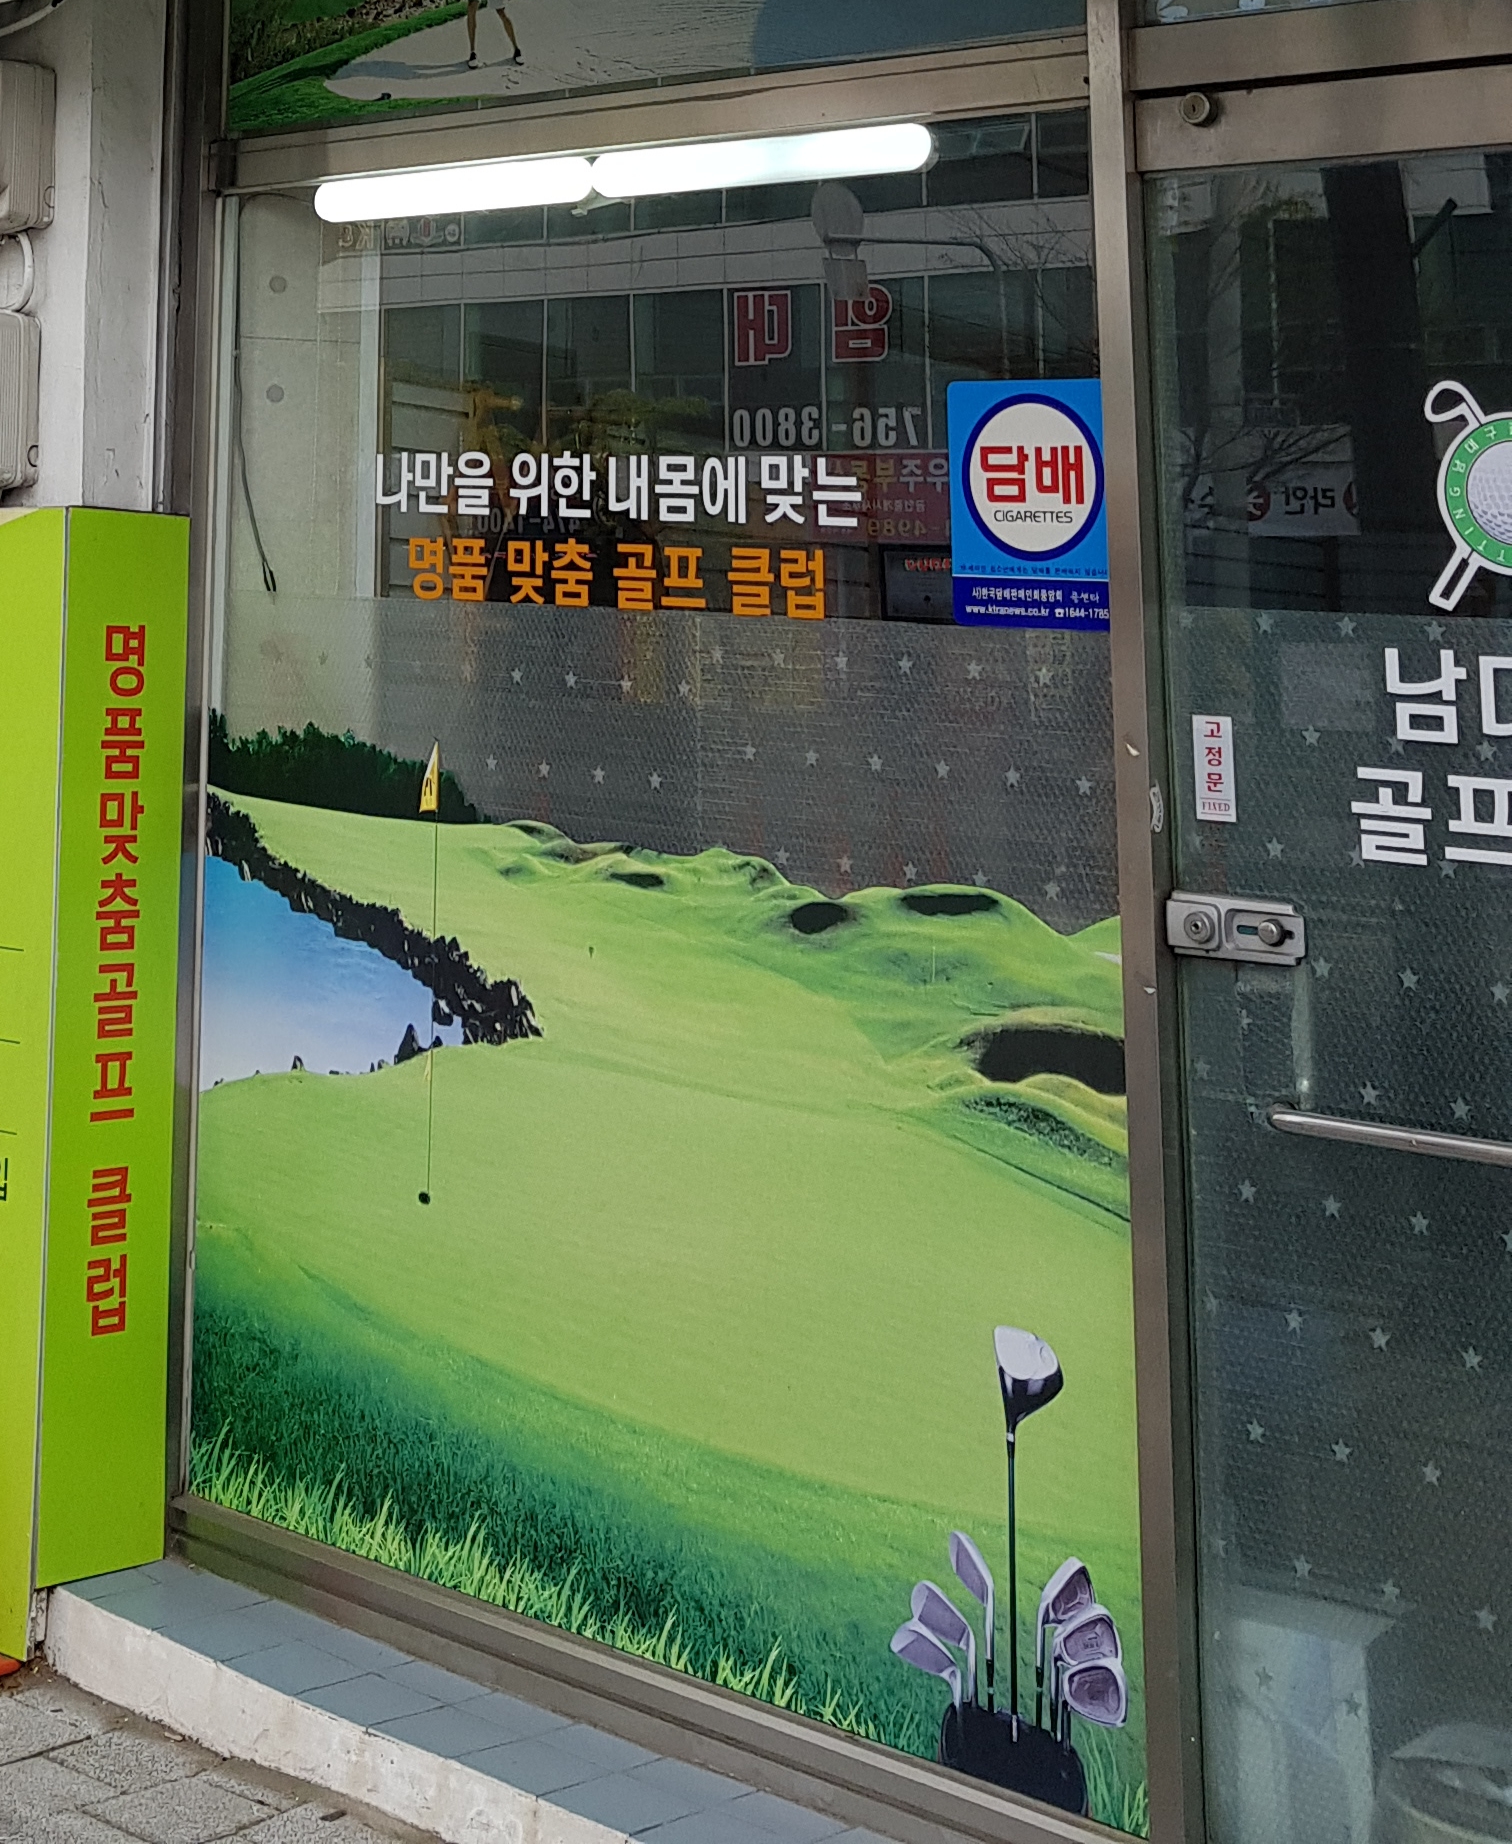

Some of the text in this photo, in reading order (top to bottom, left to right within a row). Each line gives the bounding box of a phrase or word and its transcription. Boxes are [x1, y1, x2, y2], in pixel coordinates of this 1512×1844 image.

[375, 450, 863, 530] 나만을 위한 내몸에 맞는
[979, 443, 1085, 507] 담배
[993, 508, 1074, 525] CIGARETTES
[407, 537, 827, 621] 명품 맞춤 골프 클럽
[1202, 720, 1225, 794] 고정문
[1202, 800, 1232, 813] FIXED
[85, 1165, 132, 1338] 클럽
